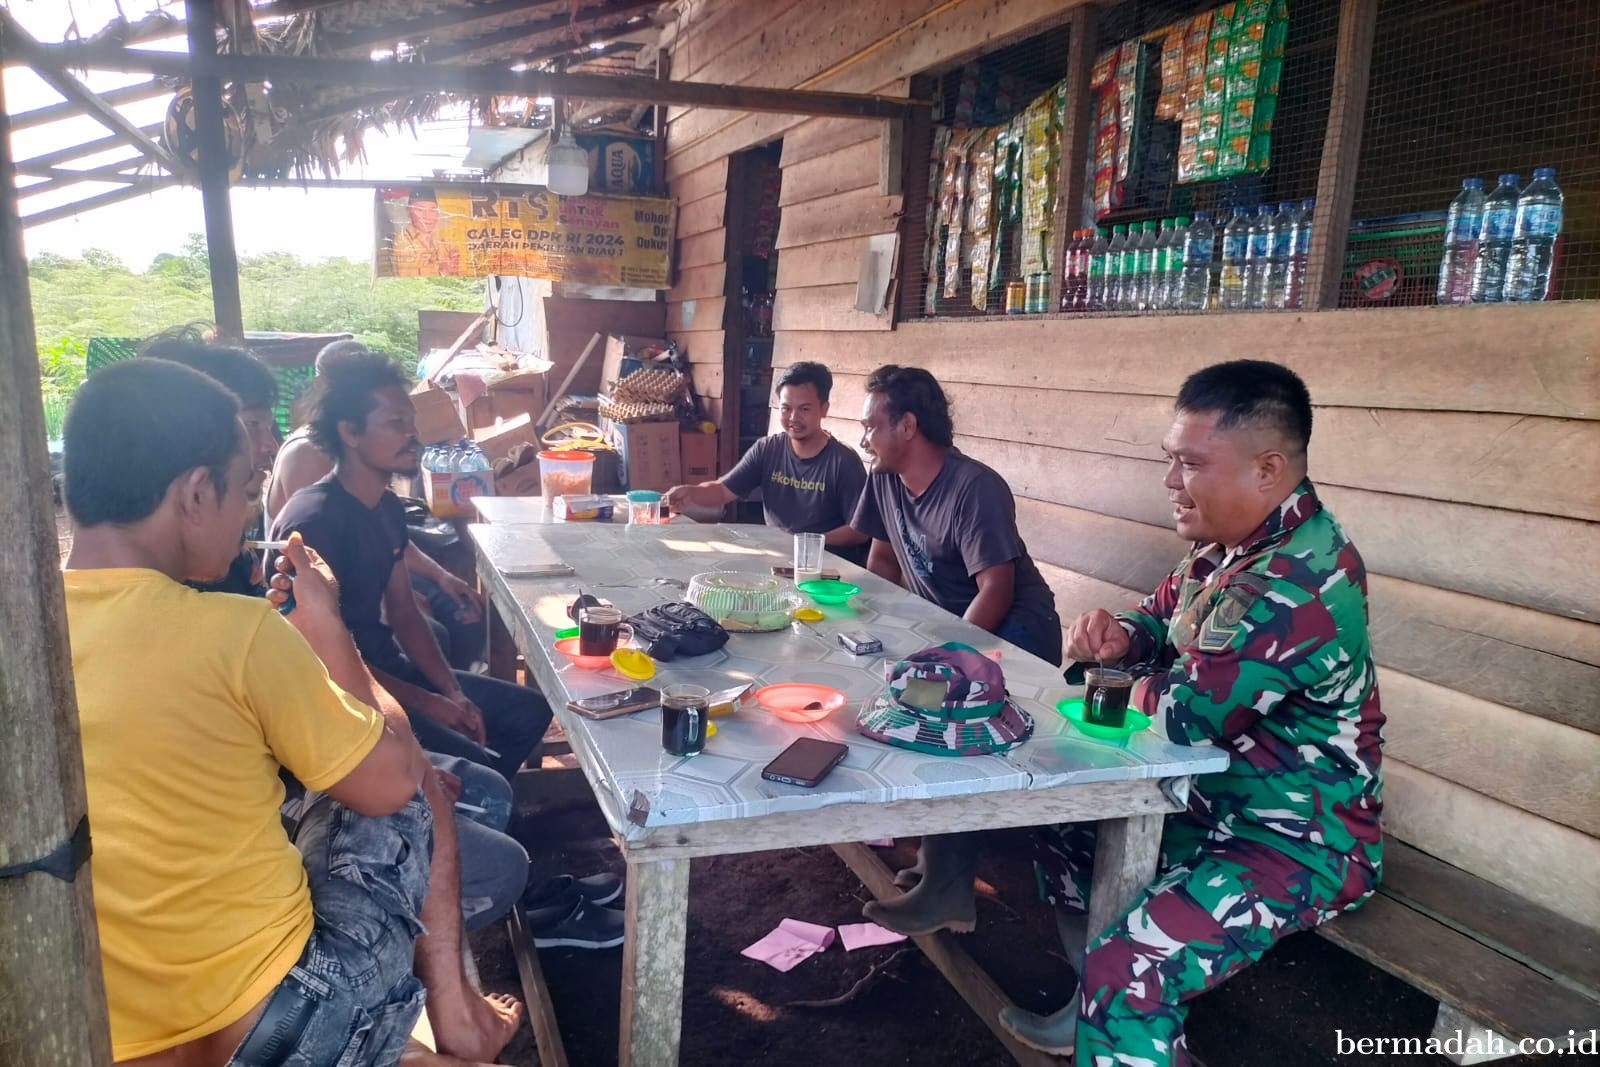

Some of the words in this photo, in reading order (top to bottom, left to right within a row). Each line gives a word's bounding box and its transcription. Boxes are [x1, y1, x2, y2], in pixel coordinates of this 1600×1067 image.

[611, 150, 625, 188] AQUA
[470, 187, 550, 221] RTS
[466, 227, 523, 240] CALEG
[527, 229, 562, 242] DPR
[566, 231, 582, 244] RI
[586, 233, 625, 247] 2024
[467, 240, 519, 251] DAERAH
[587, 246, 616, 257] RIAU
[771, 471, 826, 491] #kotabaru
